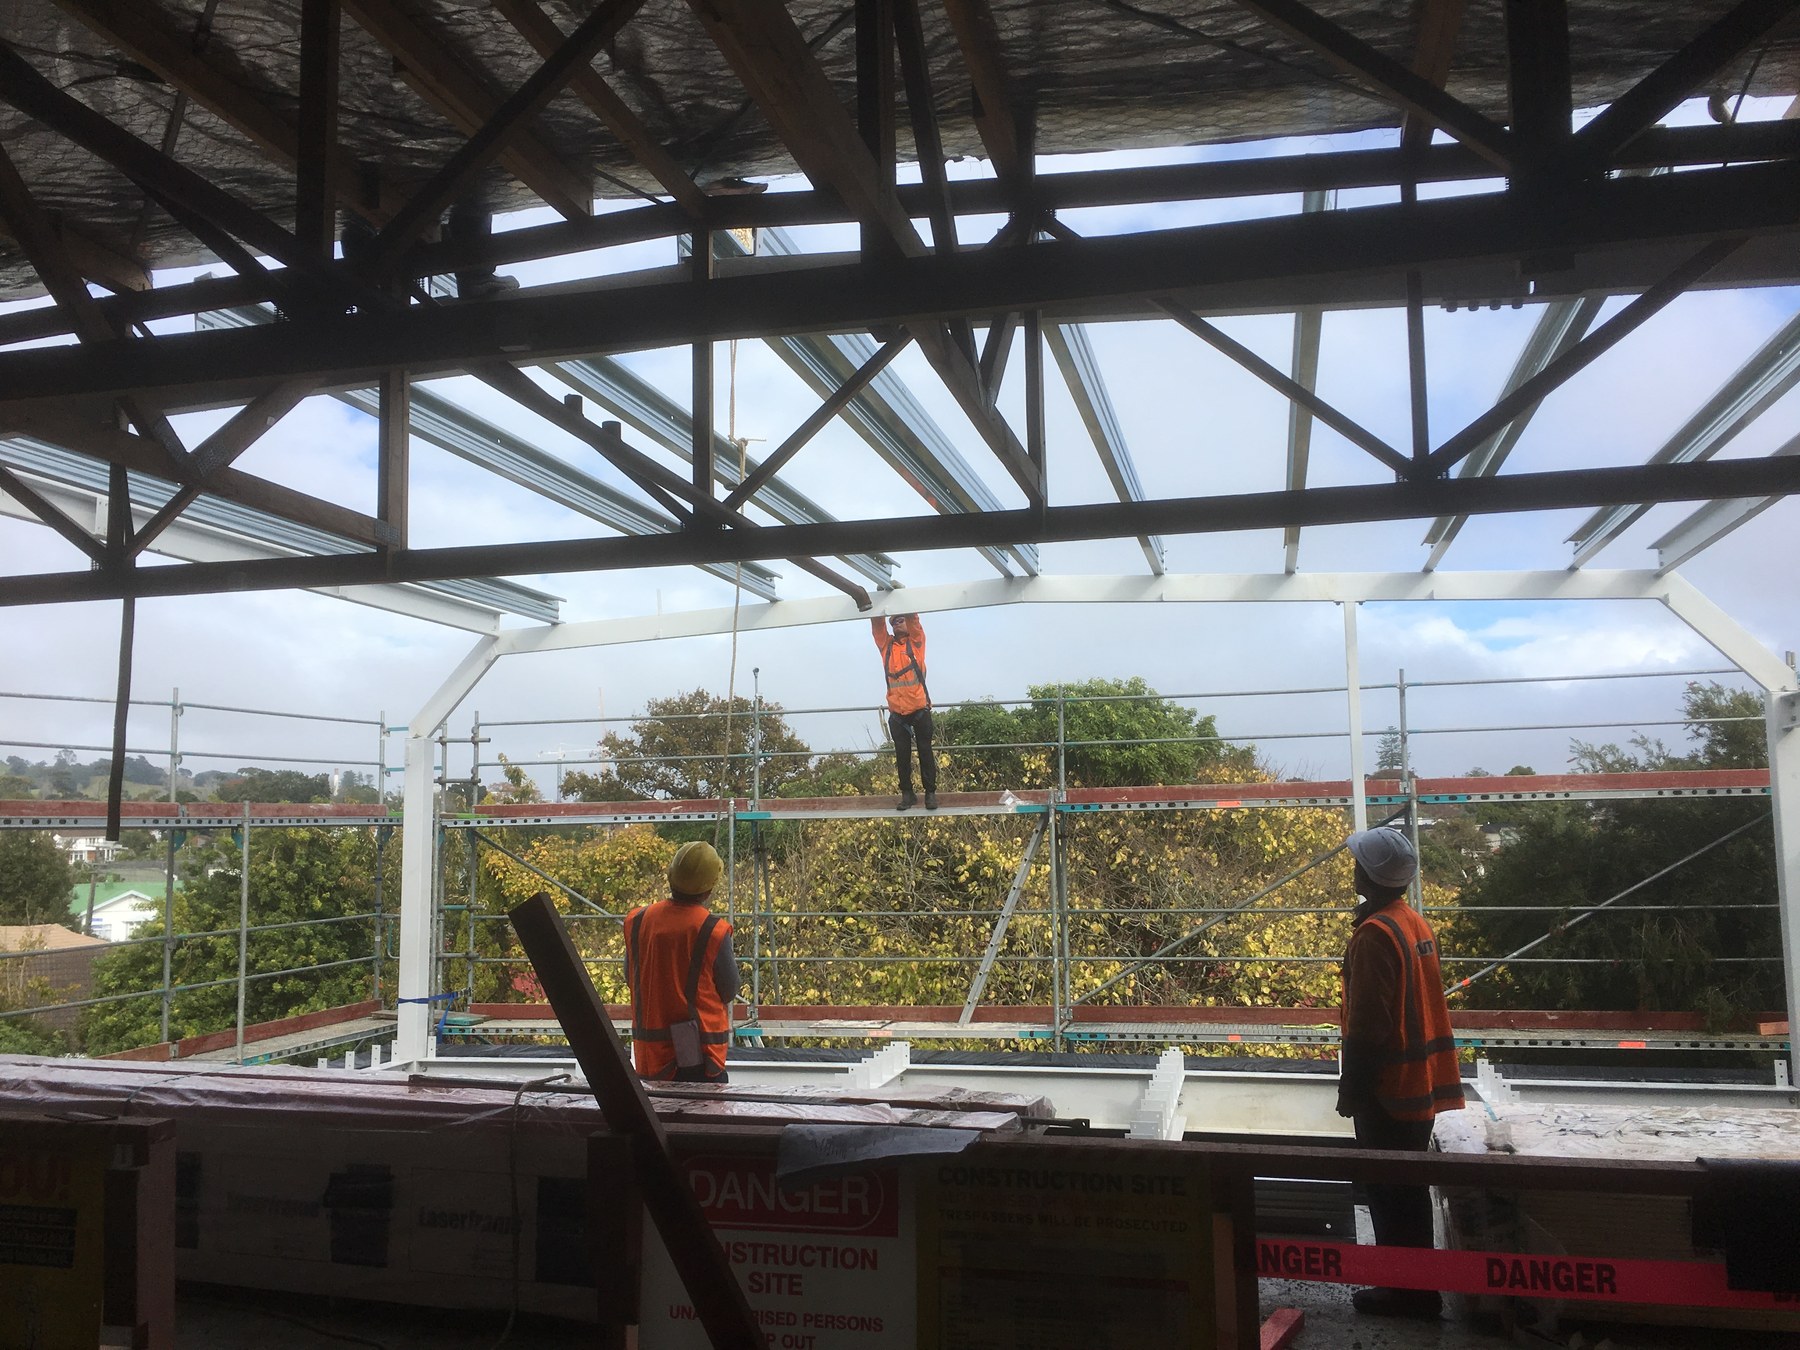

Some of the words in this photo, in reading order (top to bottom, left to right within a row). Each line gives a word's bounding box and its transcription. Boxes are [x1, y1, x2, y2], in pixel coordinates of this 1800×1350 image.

[0, 1154, 71, 1201] OU!
[688, 1168, 871, 1215] DANGER
[937, 1166, 1124, 1193] CONSTRUCTION
[1131, 1173, 1187, 1196] SITE
[938, 1208, 1034, 1226] TRESPASSERS
[1038, 1213, 1069, 1227] WILL
[1074, 1216, 1090, 1228] BE
[1096, 1217, 1188, 1233] PROSECUTED
[720, 1242, 878, 1271] NSTRUCTION
[1257, 1243, 1342, 1277] NGER
[748, 1271, 803, 1297] SITE
[1486, 1257, 1617, 1294] DANGER
[803, 1313, 883, 1332] PERSONS
[780, 1334, 816, 1350] OUT
